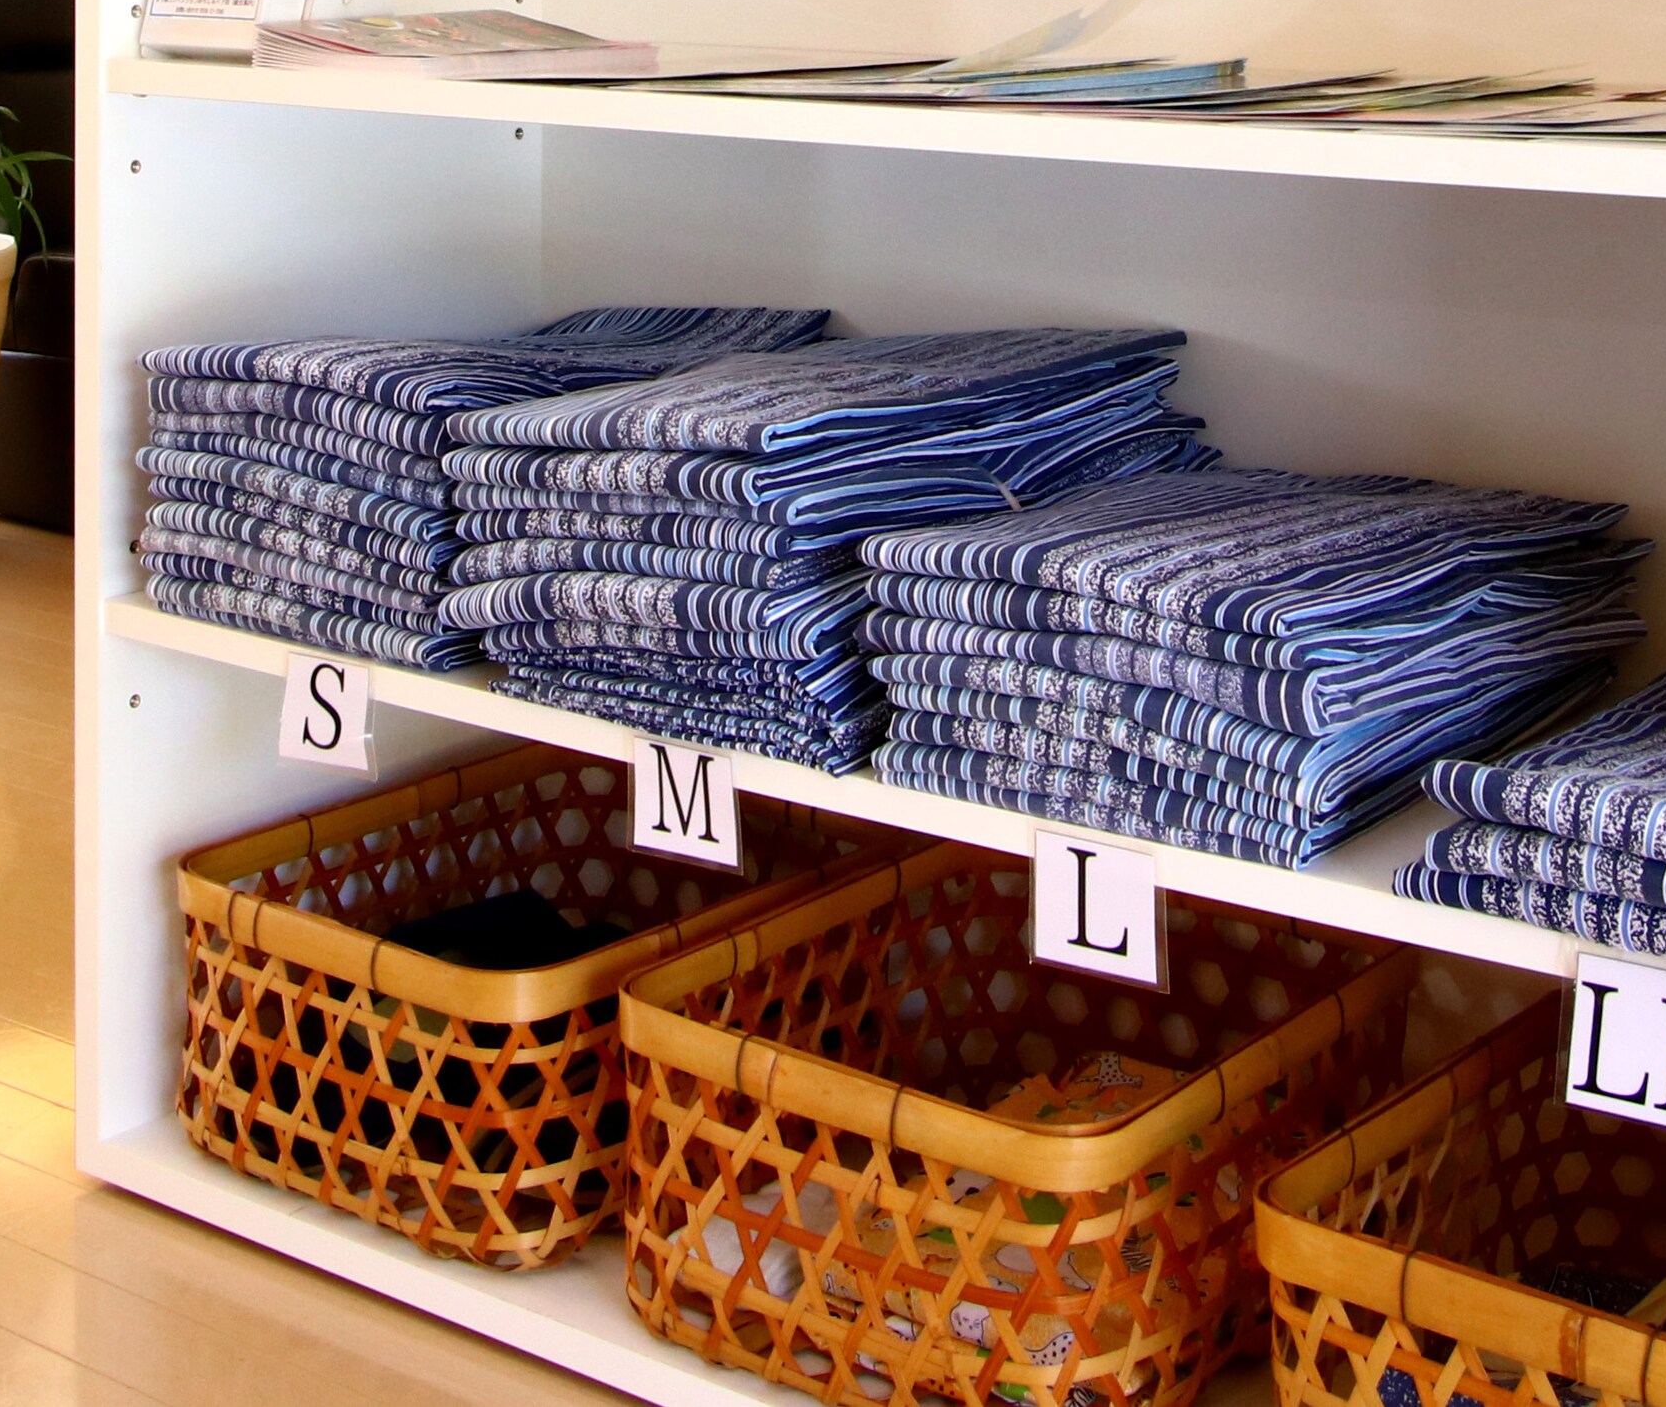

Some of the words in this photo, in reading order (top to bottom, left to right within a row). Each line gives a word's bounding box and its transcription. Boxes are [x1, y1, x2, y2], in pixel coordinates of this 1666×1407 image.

[302, 663, 345, 750] S
[649, 743, 719, 843] M
[1067, 847, 1128, 956] L
